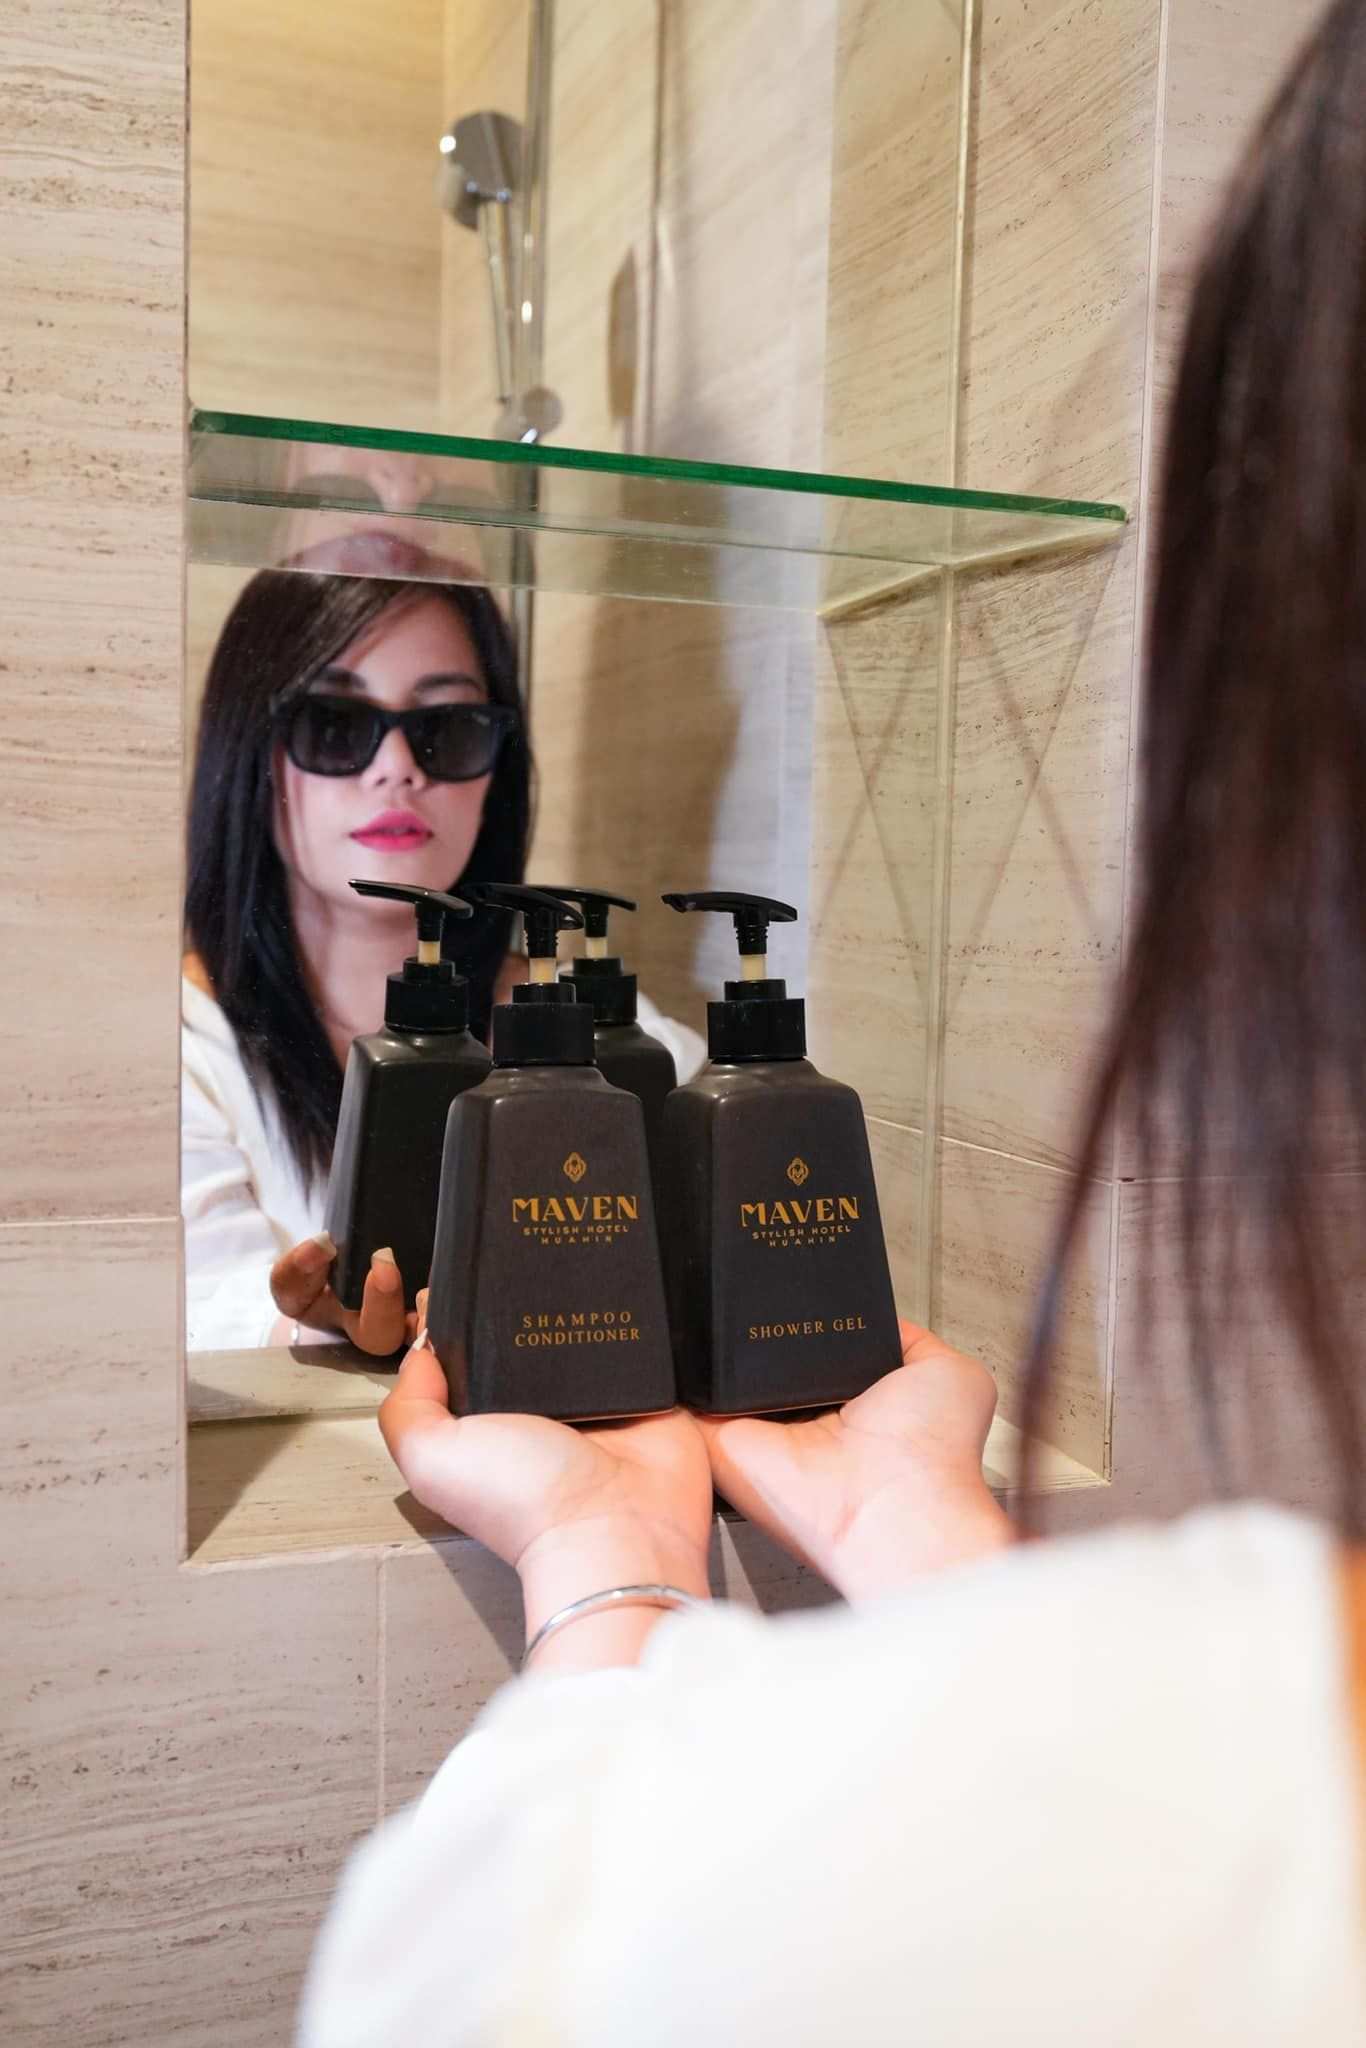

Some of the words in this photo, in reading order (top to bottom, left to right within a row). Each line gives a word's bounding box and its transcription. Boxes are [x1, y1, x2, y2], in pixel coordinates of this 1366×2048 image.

[511, 1194, 639, 1223] MAVEN
[740, 1196, 860, 1228] MAVEN
[523, 1225, 580, 1236] STYLISH
[586, 1223, 629, 1234] HOTEL
[752, 1228, 805, 1240] STYLISH
[811, 1224, 852, 1236] HOTEL
[522, 1311, 632, 1329] SHAMPOO
[749, 1321, 825, 1340] SHOWER
[832, 1316, 867, 1332] GEL
[514, 1327, 641, 1347] CONDITIONER
